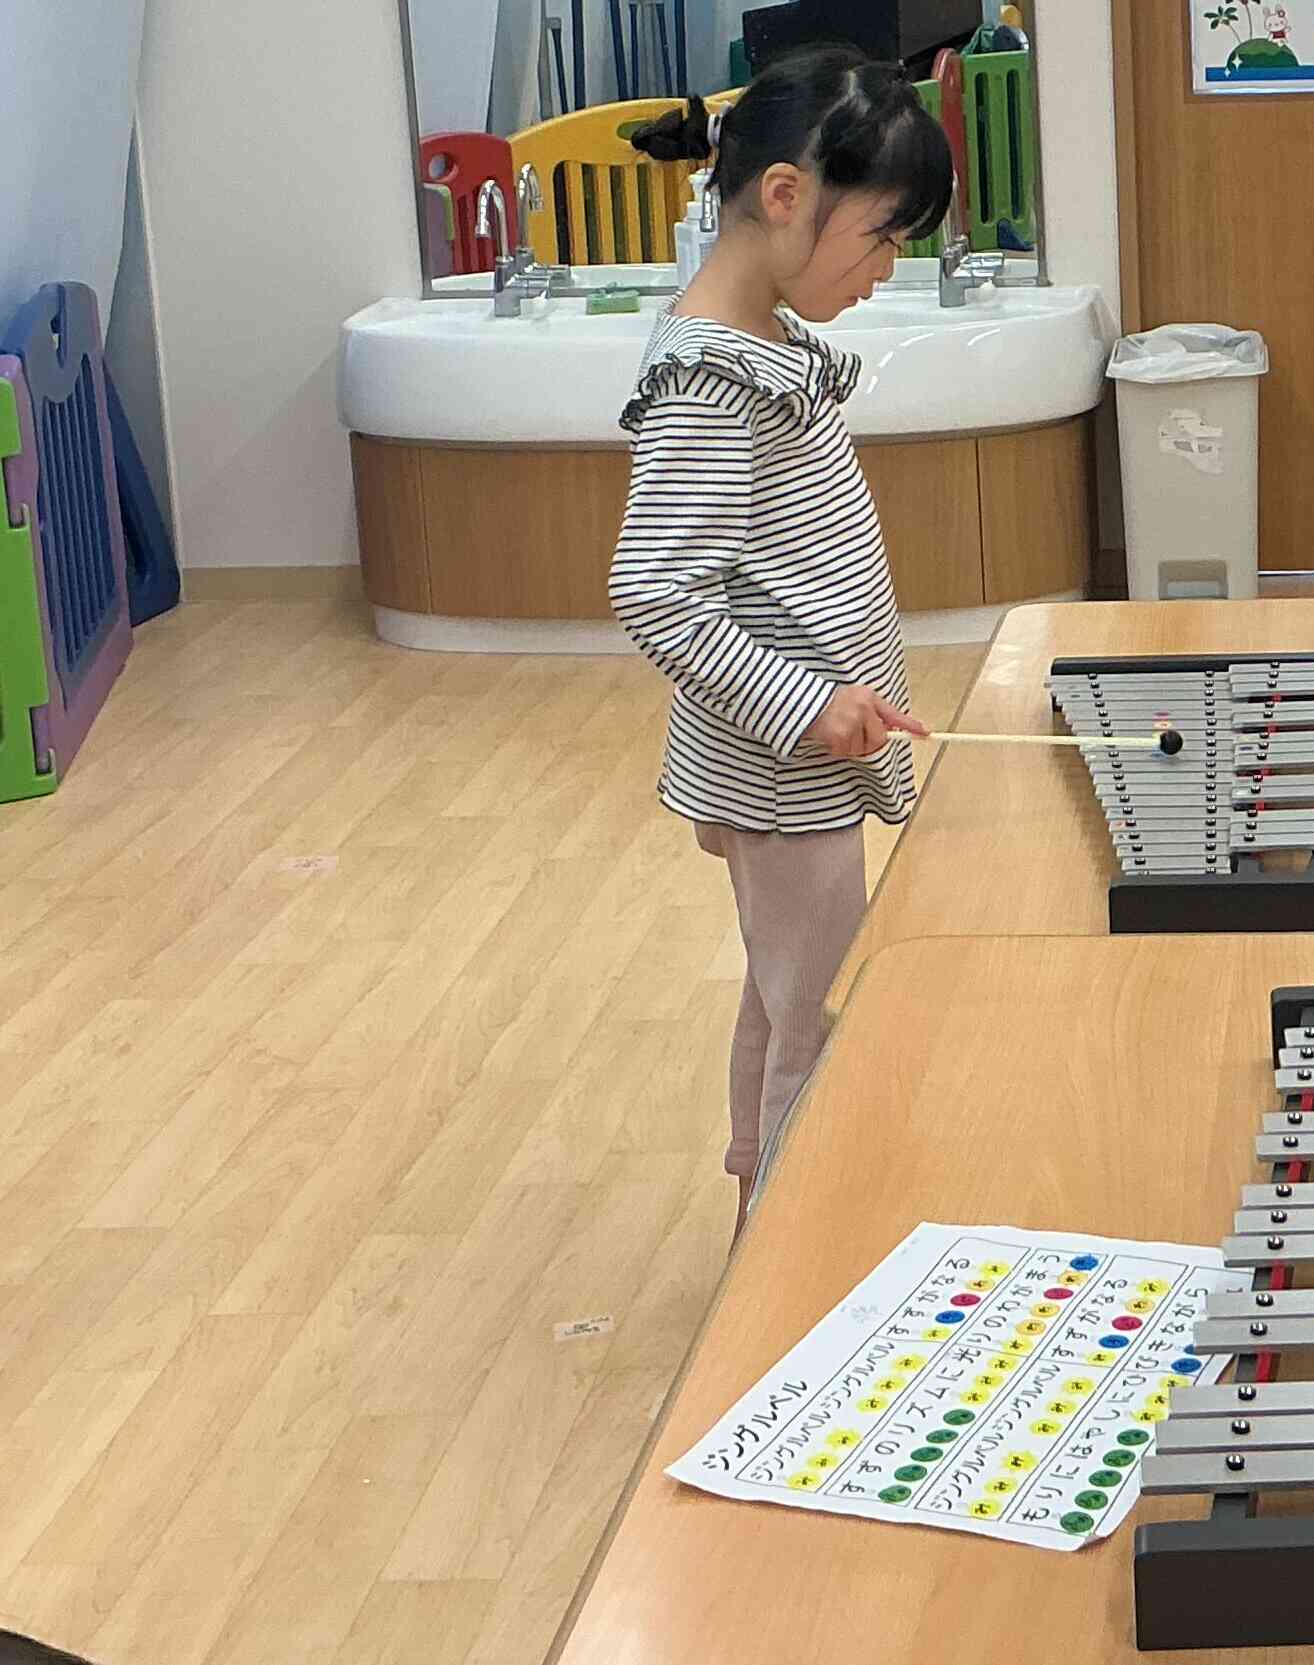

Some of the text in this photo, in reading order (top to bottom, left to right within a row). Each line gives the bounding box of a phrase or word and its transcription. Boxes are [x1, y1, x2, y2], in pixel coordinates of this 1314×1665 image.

[702, 1380, 807, 1471] ジングルベル
